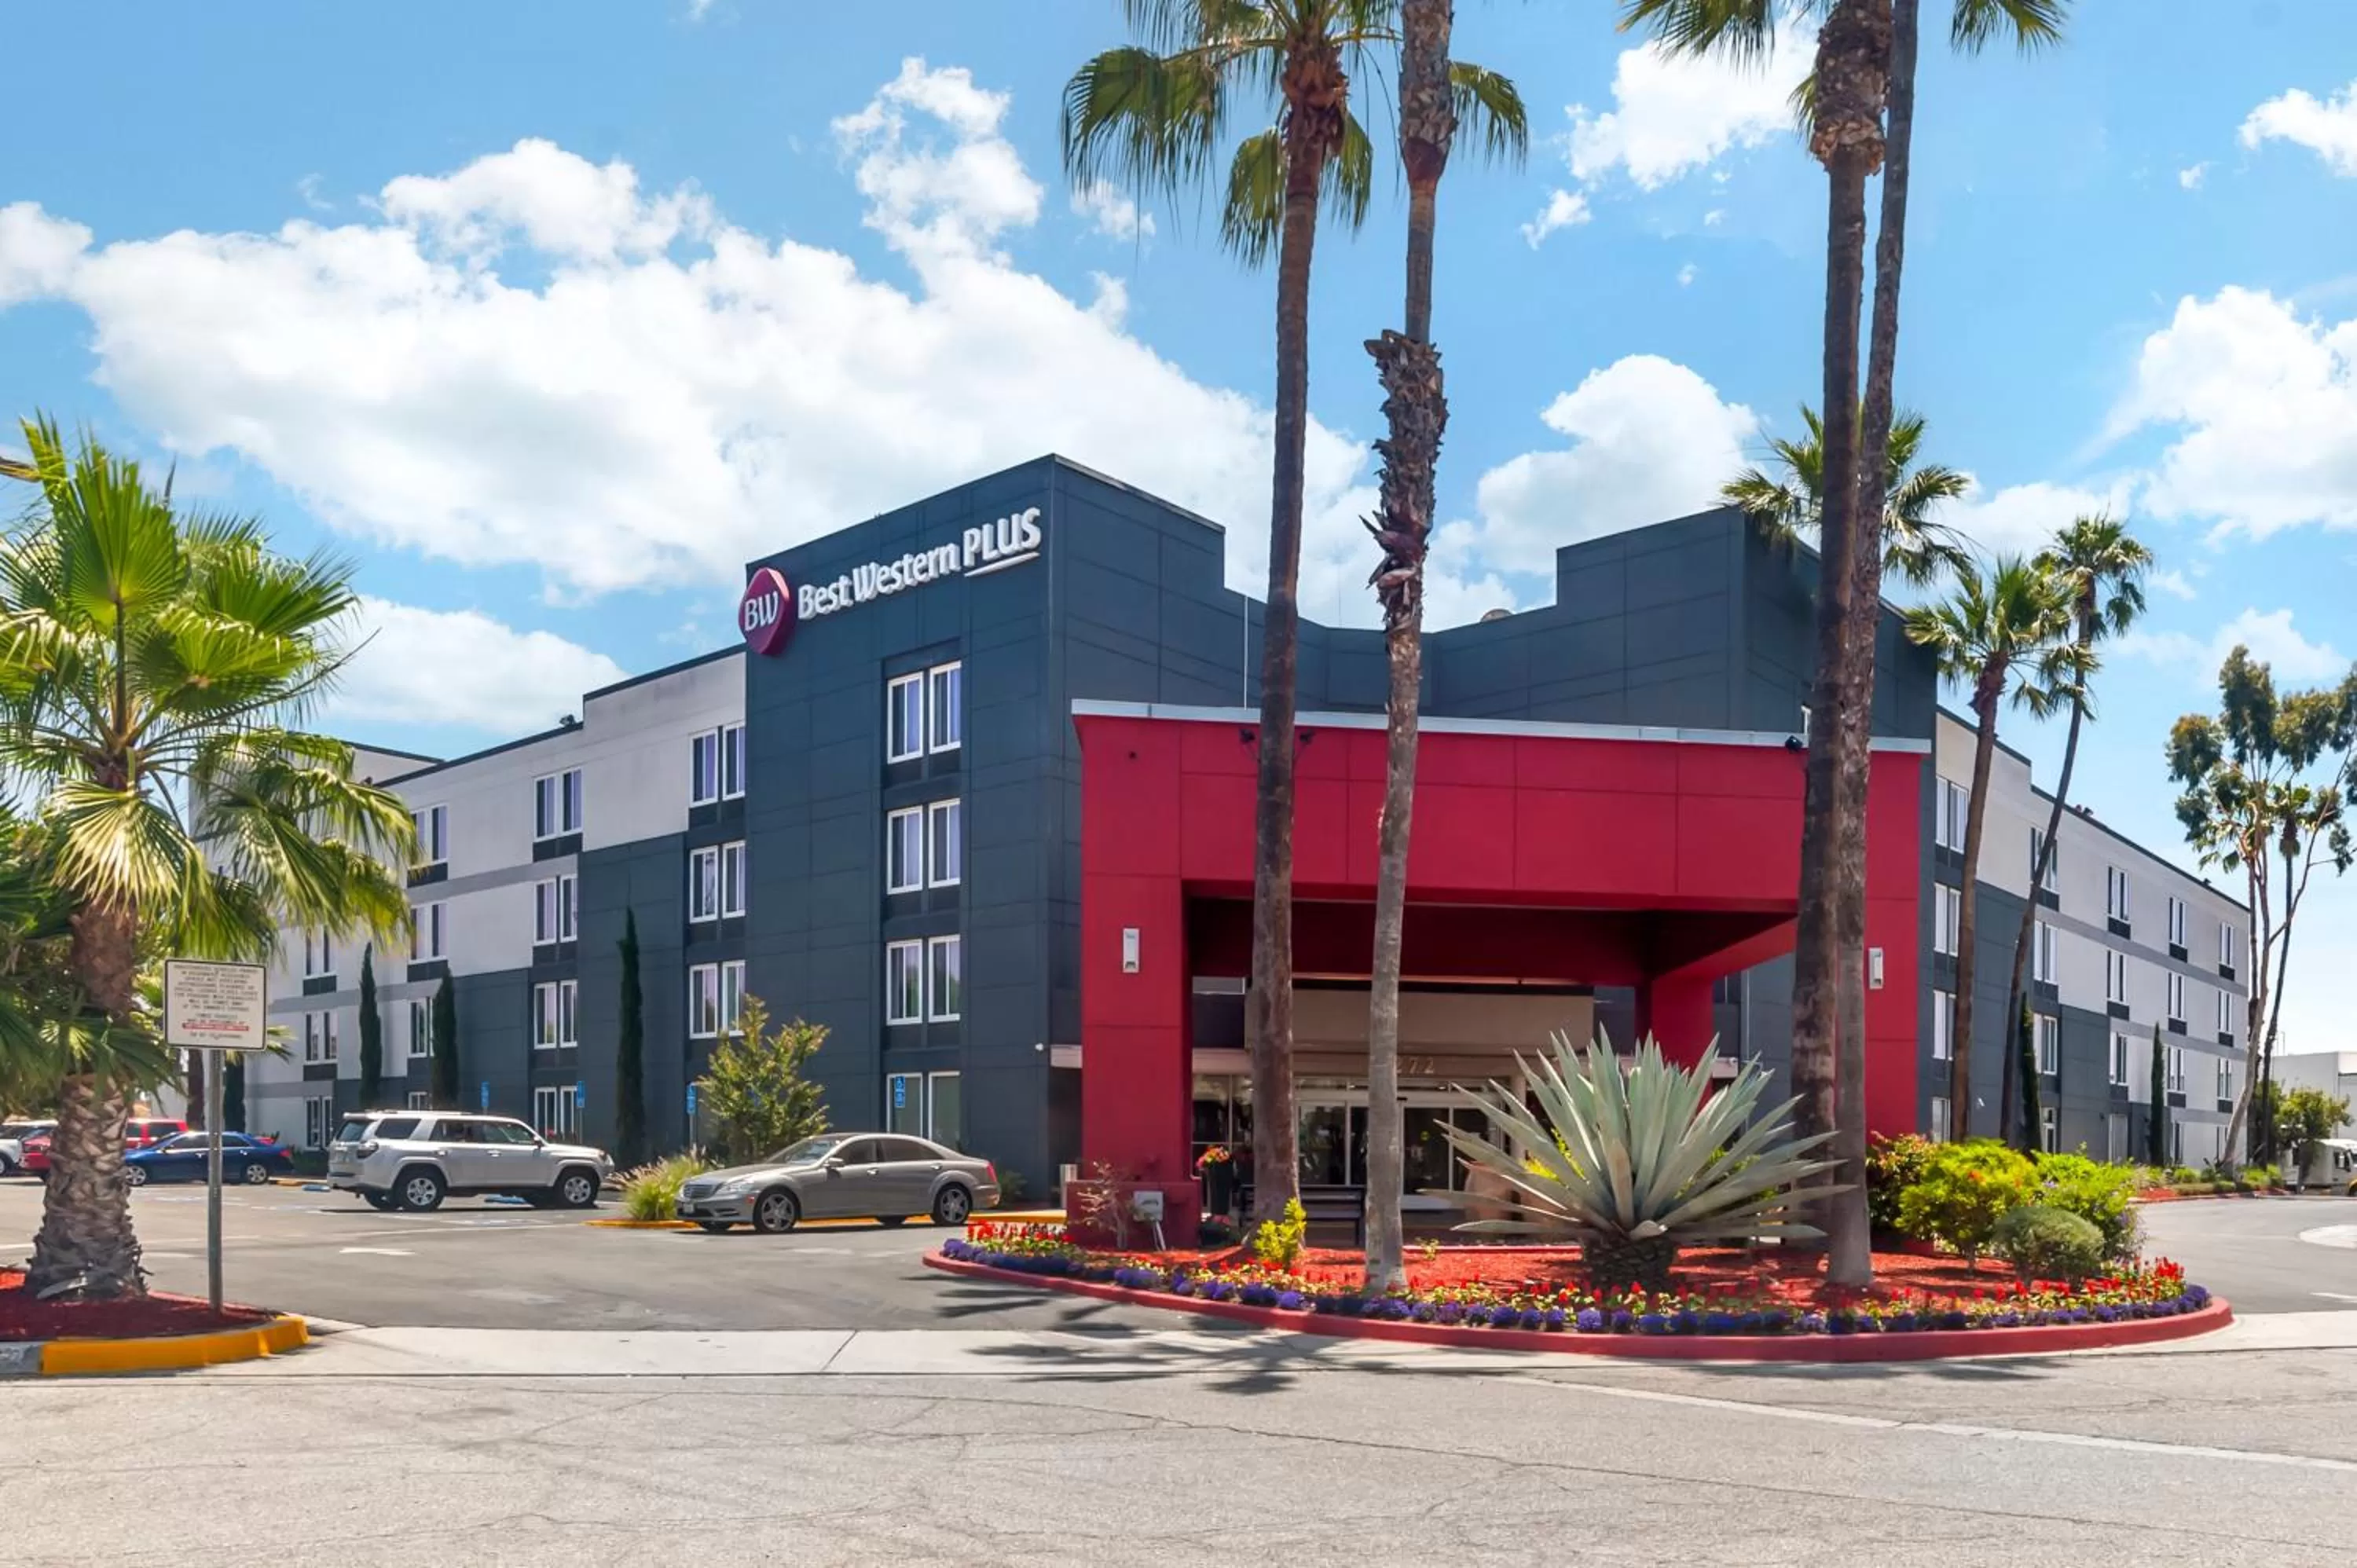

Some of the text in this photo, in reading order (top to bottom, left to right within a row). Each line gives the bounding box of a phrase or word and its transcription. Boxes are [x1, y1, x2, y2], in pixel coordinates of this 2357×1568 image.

[798, 507, 1041, 619] Best Western PLUS
[745, 591, 779, 632] BW
